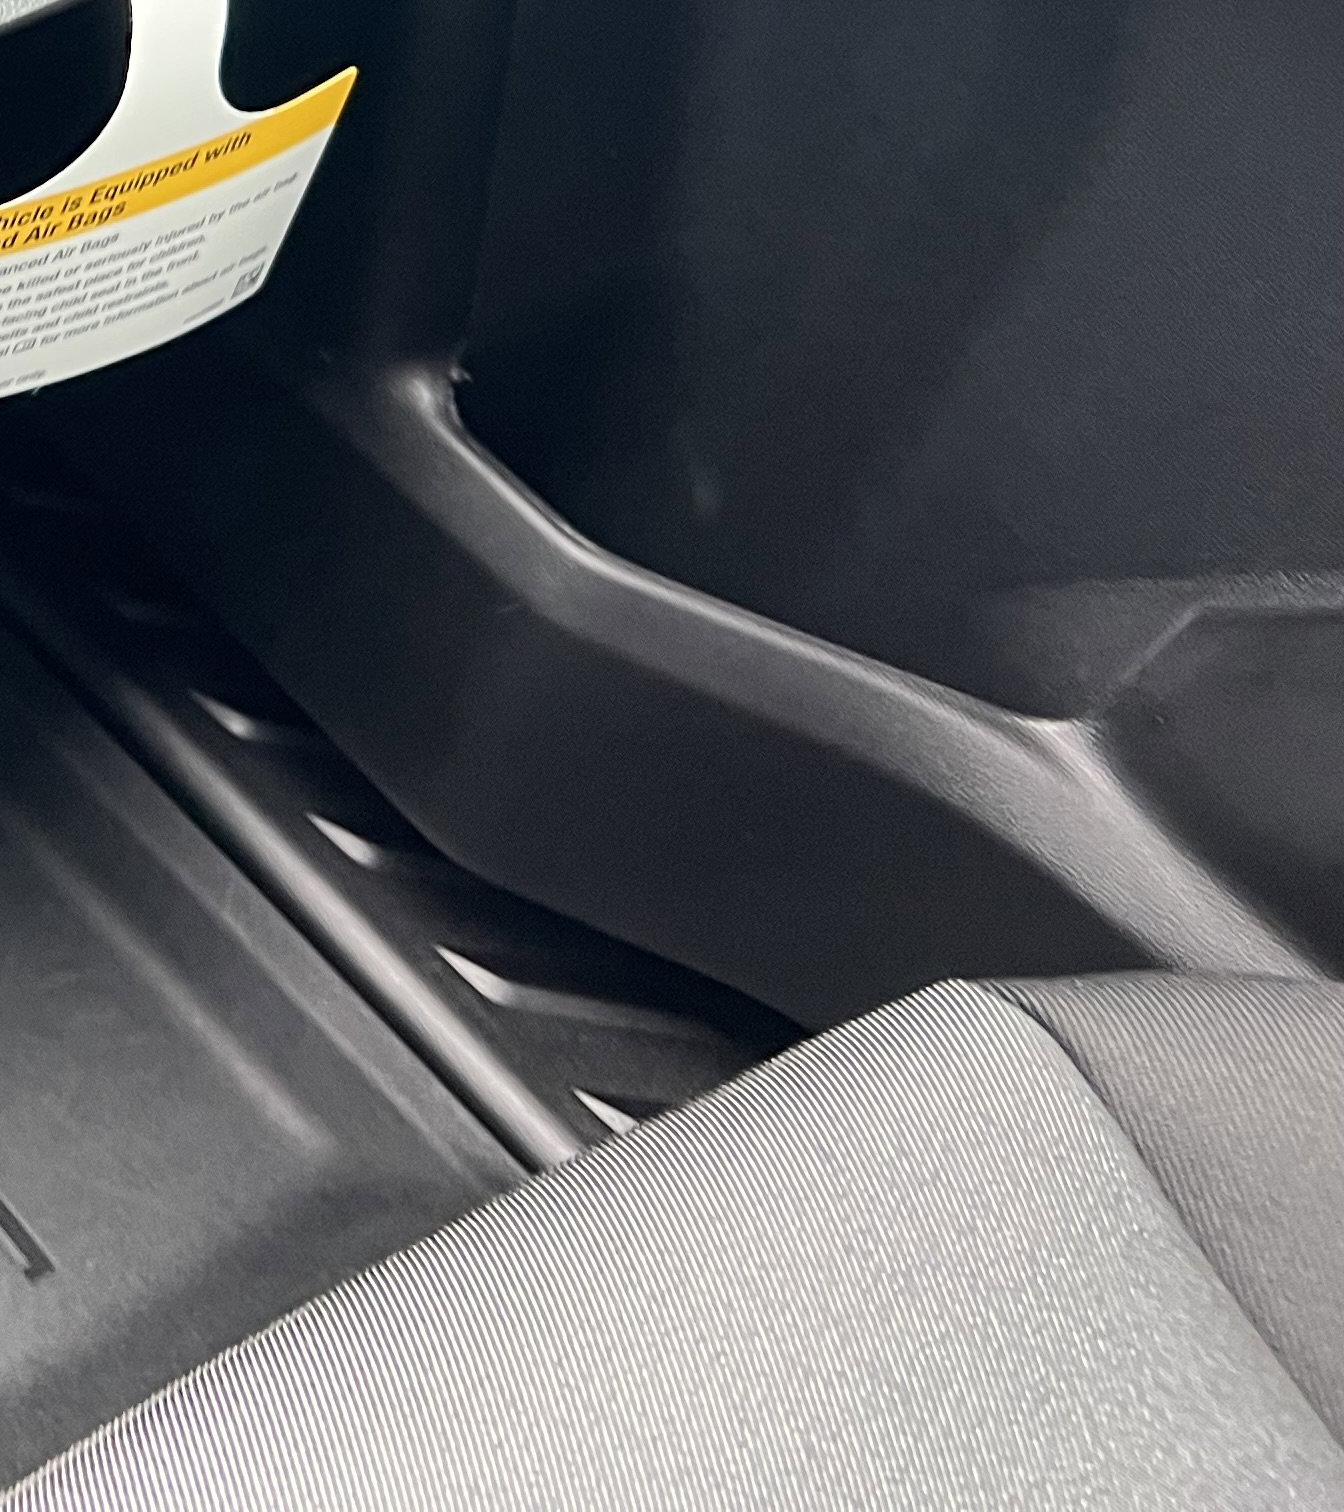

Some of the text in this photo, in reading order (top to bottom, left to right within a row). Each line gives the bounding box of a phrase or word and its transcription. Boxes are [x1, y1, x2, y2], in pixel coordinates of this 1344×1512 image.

[61, 196, 83, 214] is
[89, 150, 199, 205] Equipped
[205, 132, 252, 164] with
[24, 221, 61, 244] Air
[66, 200, 127, 232] Bags
[16, 270, 60, 293] killed
[64, 263, 80, 277] or
[85, 239, 153, 270] seriously
[155, 216, 206, 246] injured
[208, 209, 226, 228] by
[51, 245, 74, 264] Air
[80, 232, 119, 254] Bags
[8, 294, 31, 310] the
[35, 279, 81, 301] safest
[83, 267, 124, 289] place
[126, 257, 146, 272] for
[51, 287, 87, 312] child
[91, 281, 122, 301] seat
[125, 275, 138, 288] in
[141, 264, 163, 281] the
[31, 318, 59, 334] and
[63, 303, 103, 326] child
[40, 333, 60, 347] for
